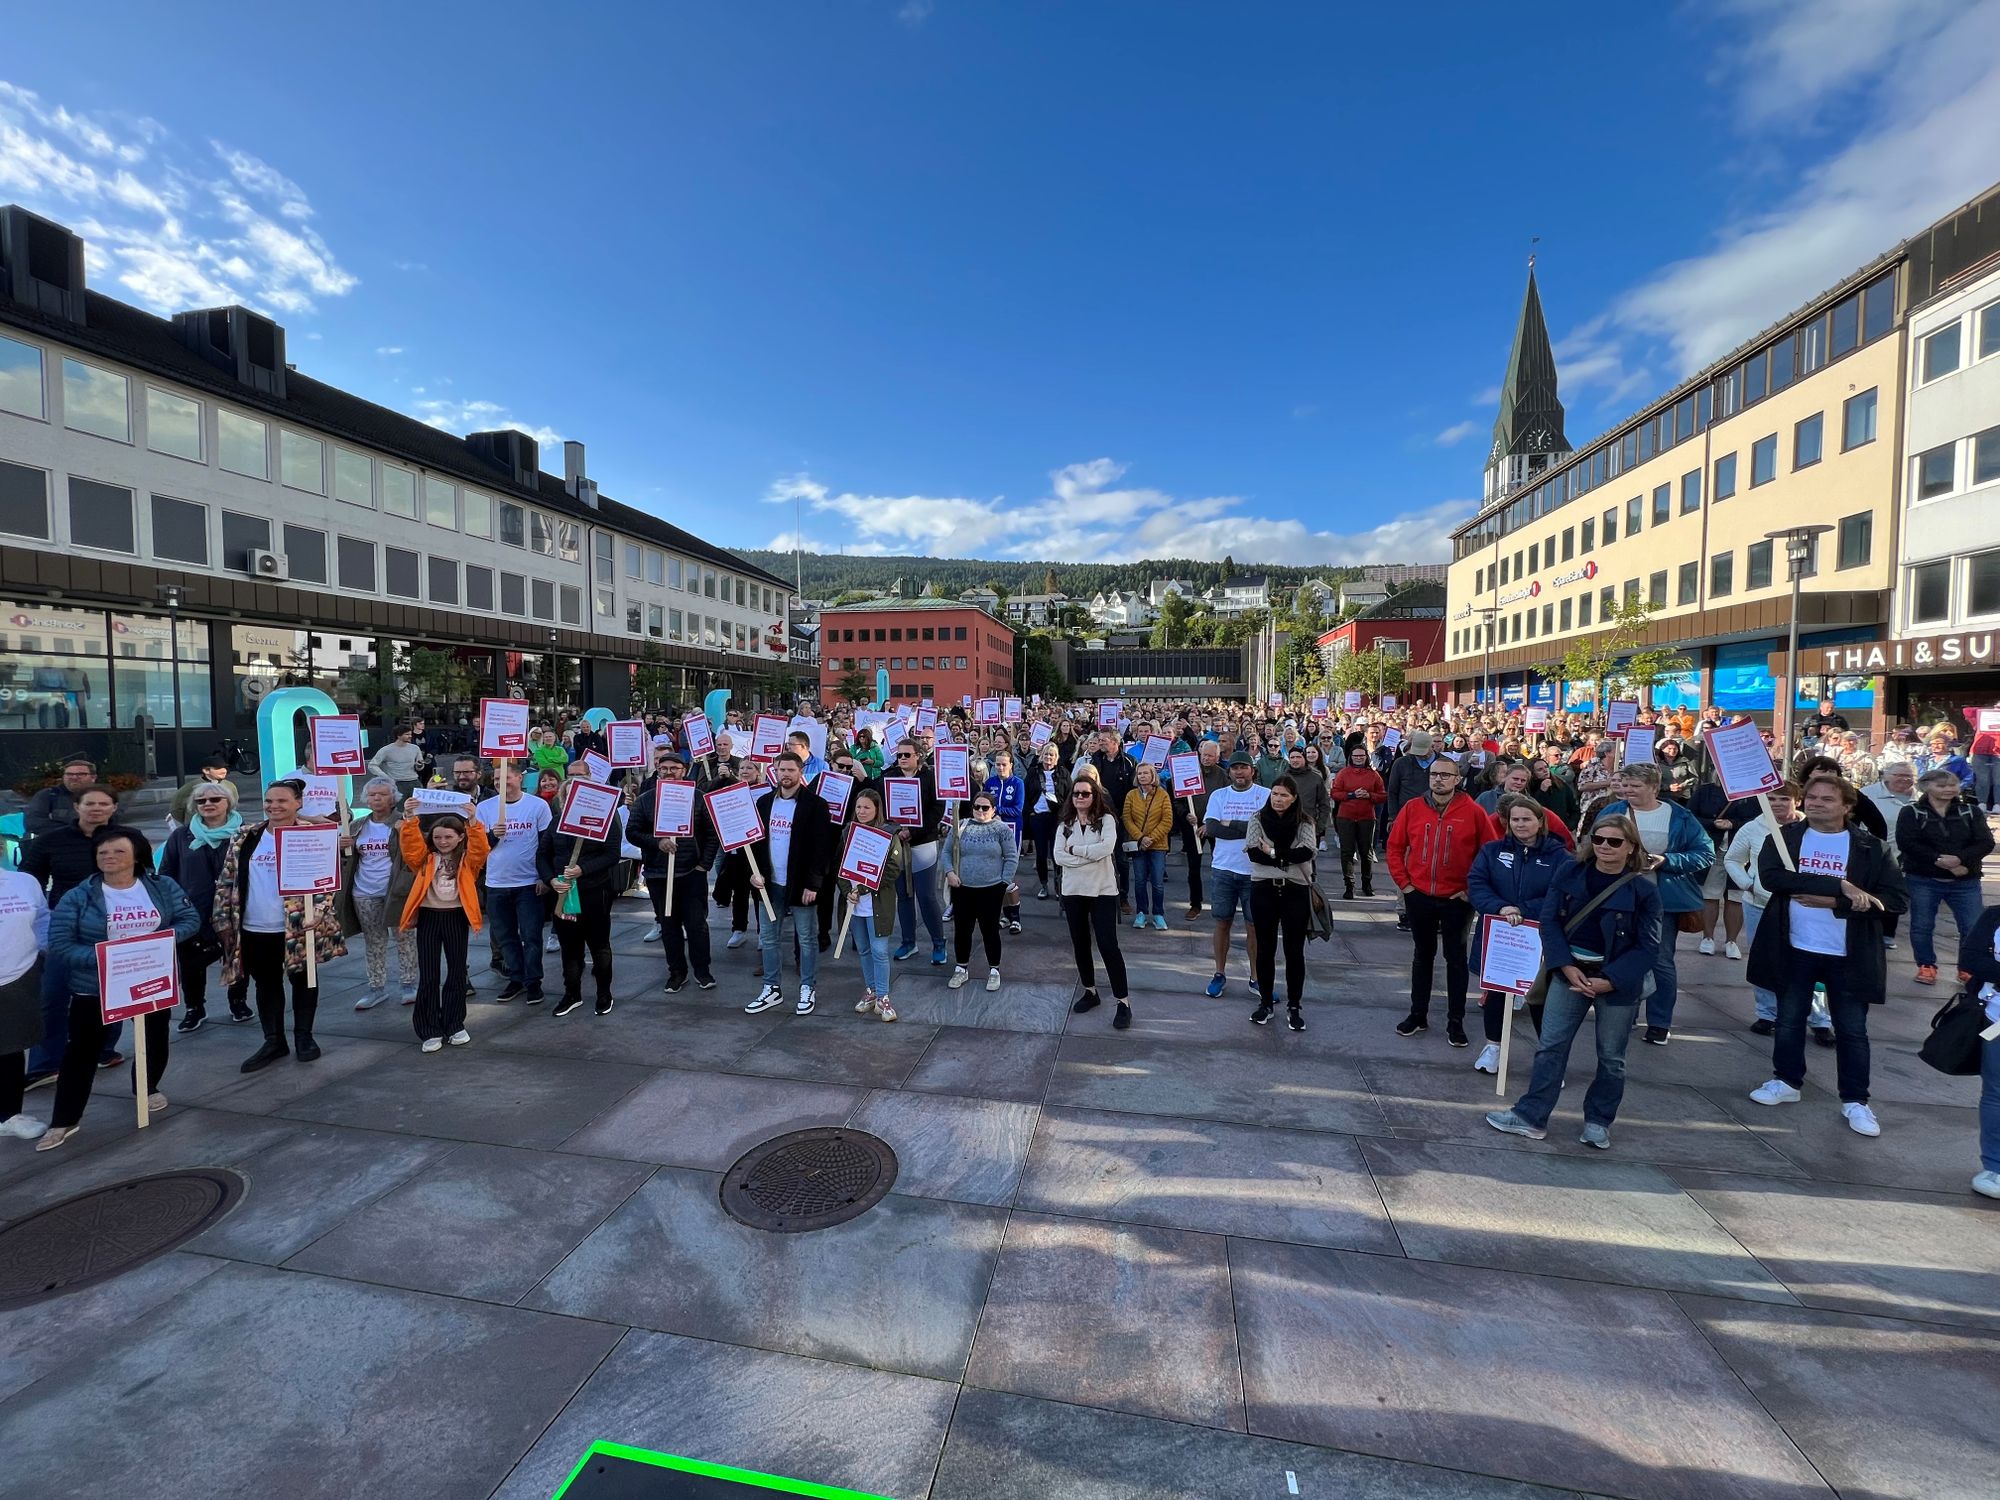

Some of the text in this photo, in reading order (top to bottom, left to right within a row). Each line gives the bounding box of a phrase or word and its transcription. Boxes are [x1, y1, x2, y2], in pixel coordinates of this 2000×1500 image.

[1813, 850, 1841, 861] Berre
[1799, 857, 1847, 872] ÆRAR
[115, 904, 143, 912] Berre
